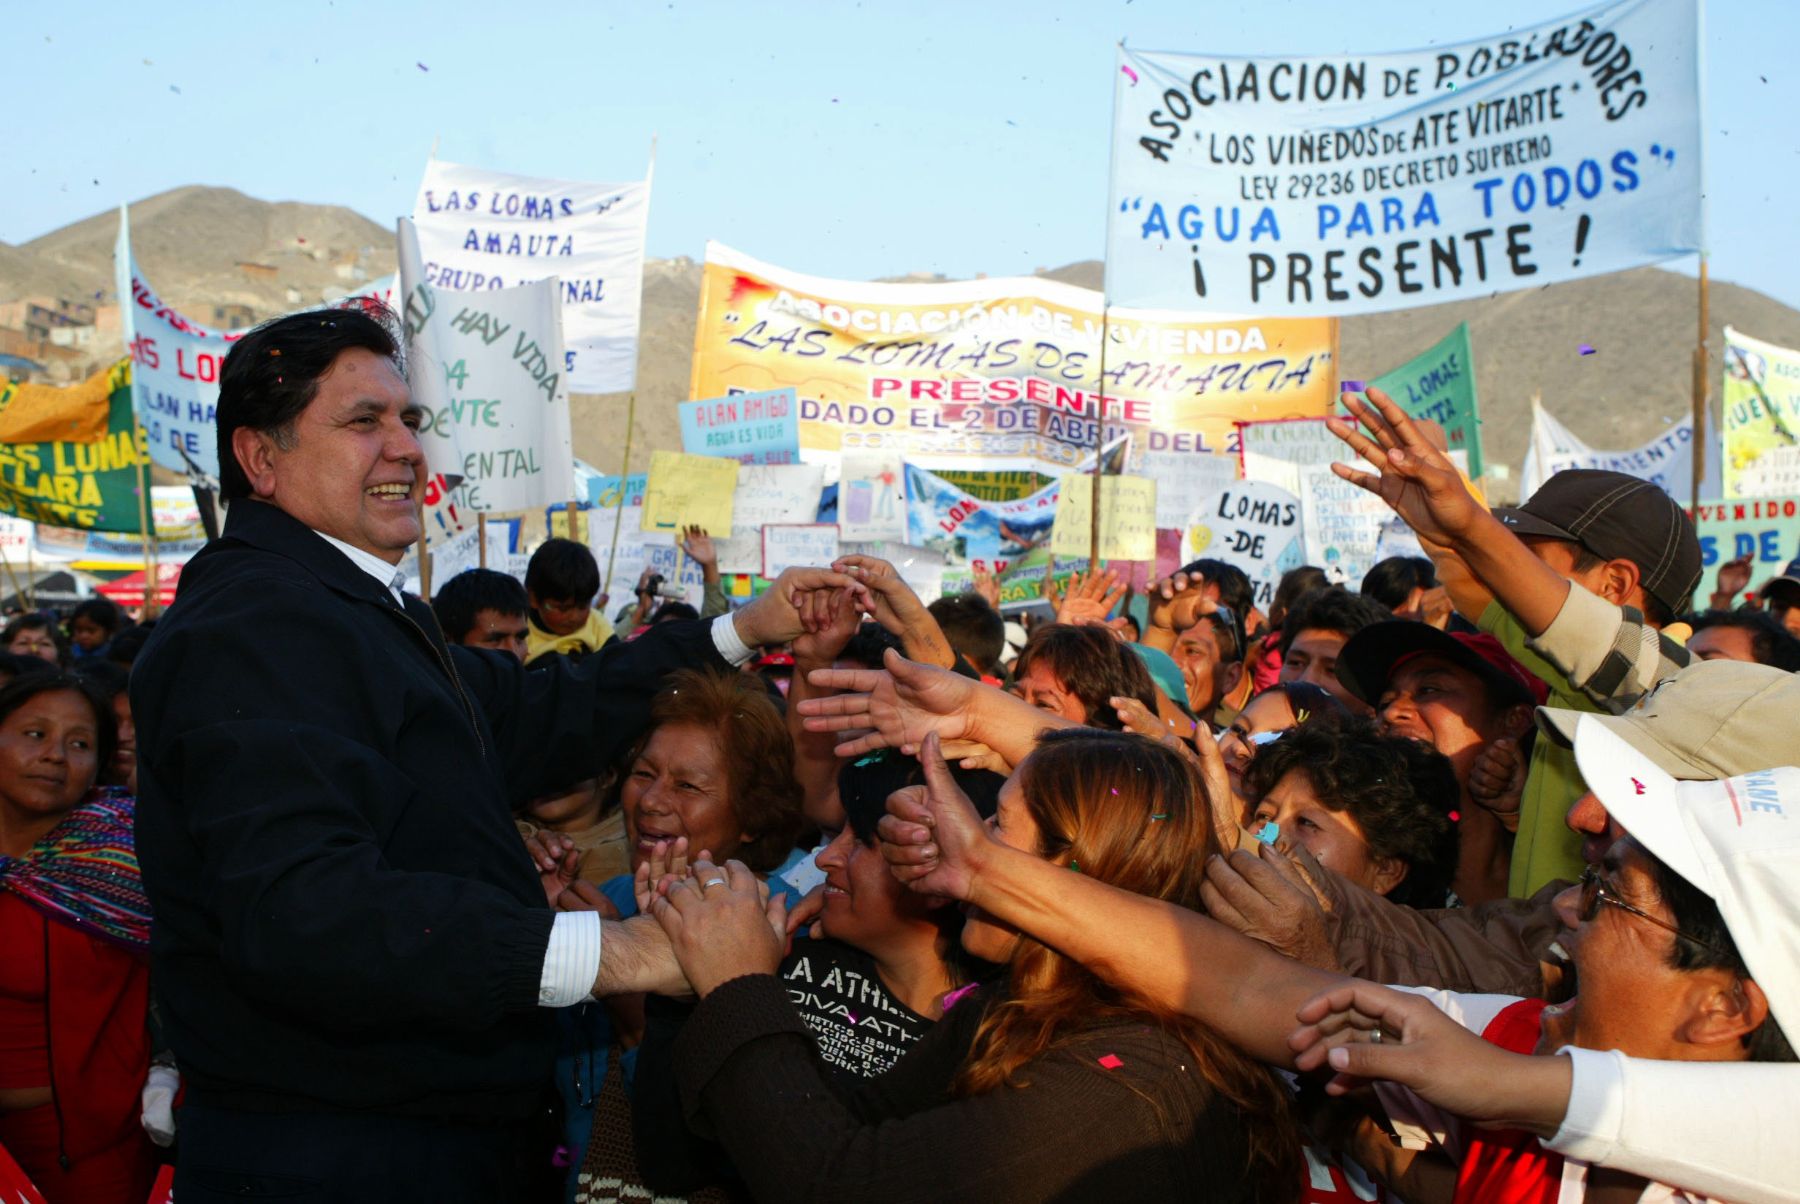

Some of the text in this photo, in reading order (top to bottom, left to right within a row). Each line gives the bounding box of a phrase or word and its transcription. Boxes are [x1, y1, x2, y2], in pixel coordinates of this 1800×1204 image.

[1138, 61, 1366, 163] ASOCIACION
[1383, 69, 1420, 98] DE
[1382, 131, 1406, 155] DE
[1412, 109, 1460, 151] ATE
[1466, 84, 1564, 139] VITARTE
[1240, 134, 1553, 201] LEY 29236 DECRETO SUPREMO
[425, 190, 481, 213] LAS
[489, 192, 575, 220] LOMAS
[1317, 191, 1441, 241] PARA
[463, 228, 574, 257] AMAUTA
[1249, 222, 1538, 303] PRESENTE
[450, 307, 511, 346] HAY
[1032, 305, 1073, 341] DE
[1084, 318, 1268, 355] VIVIENDA
[836, 338, 1023, 371] LOMAS
[1034, 341, 1089, 380] DE
[696, 394, 790, 428] ALAN AMIGO
[872, 377, 1152, 422] PRESENTE
[706, 422, 785, 447] AGUA ES VIDA
[909, 406, 950, 429] EL
[964, 409, 983, 429] 2
[996, 407, 1040, 430] DE
[1149, 432, 1213, 453] DEL
[0, 462, 104, 508] LARA
[464, 448, 541, 481] ENTAL
[1217, 491, 1296, 527] LOMAS
[1735, 529, 1781, 563] DE
